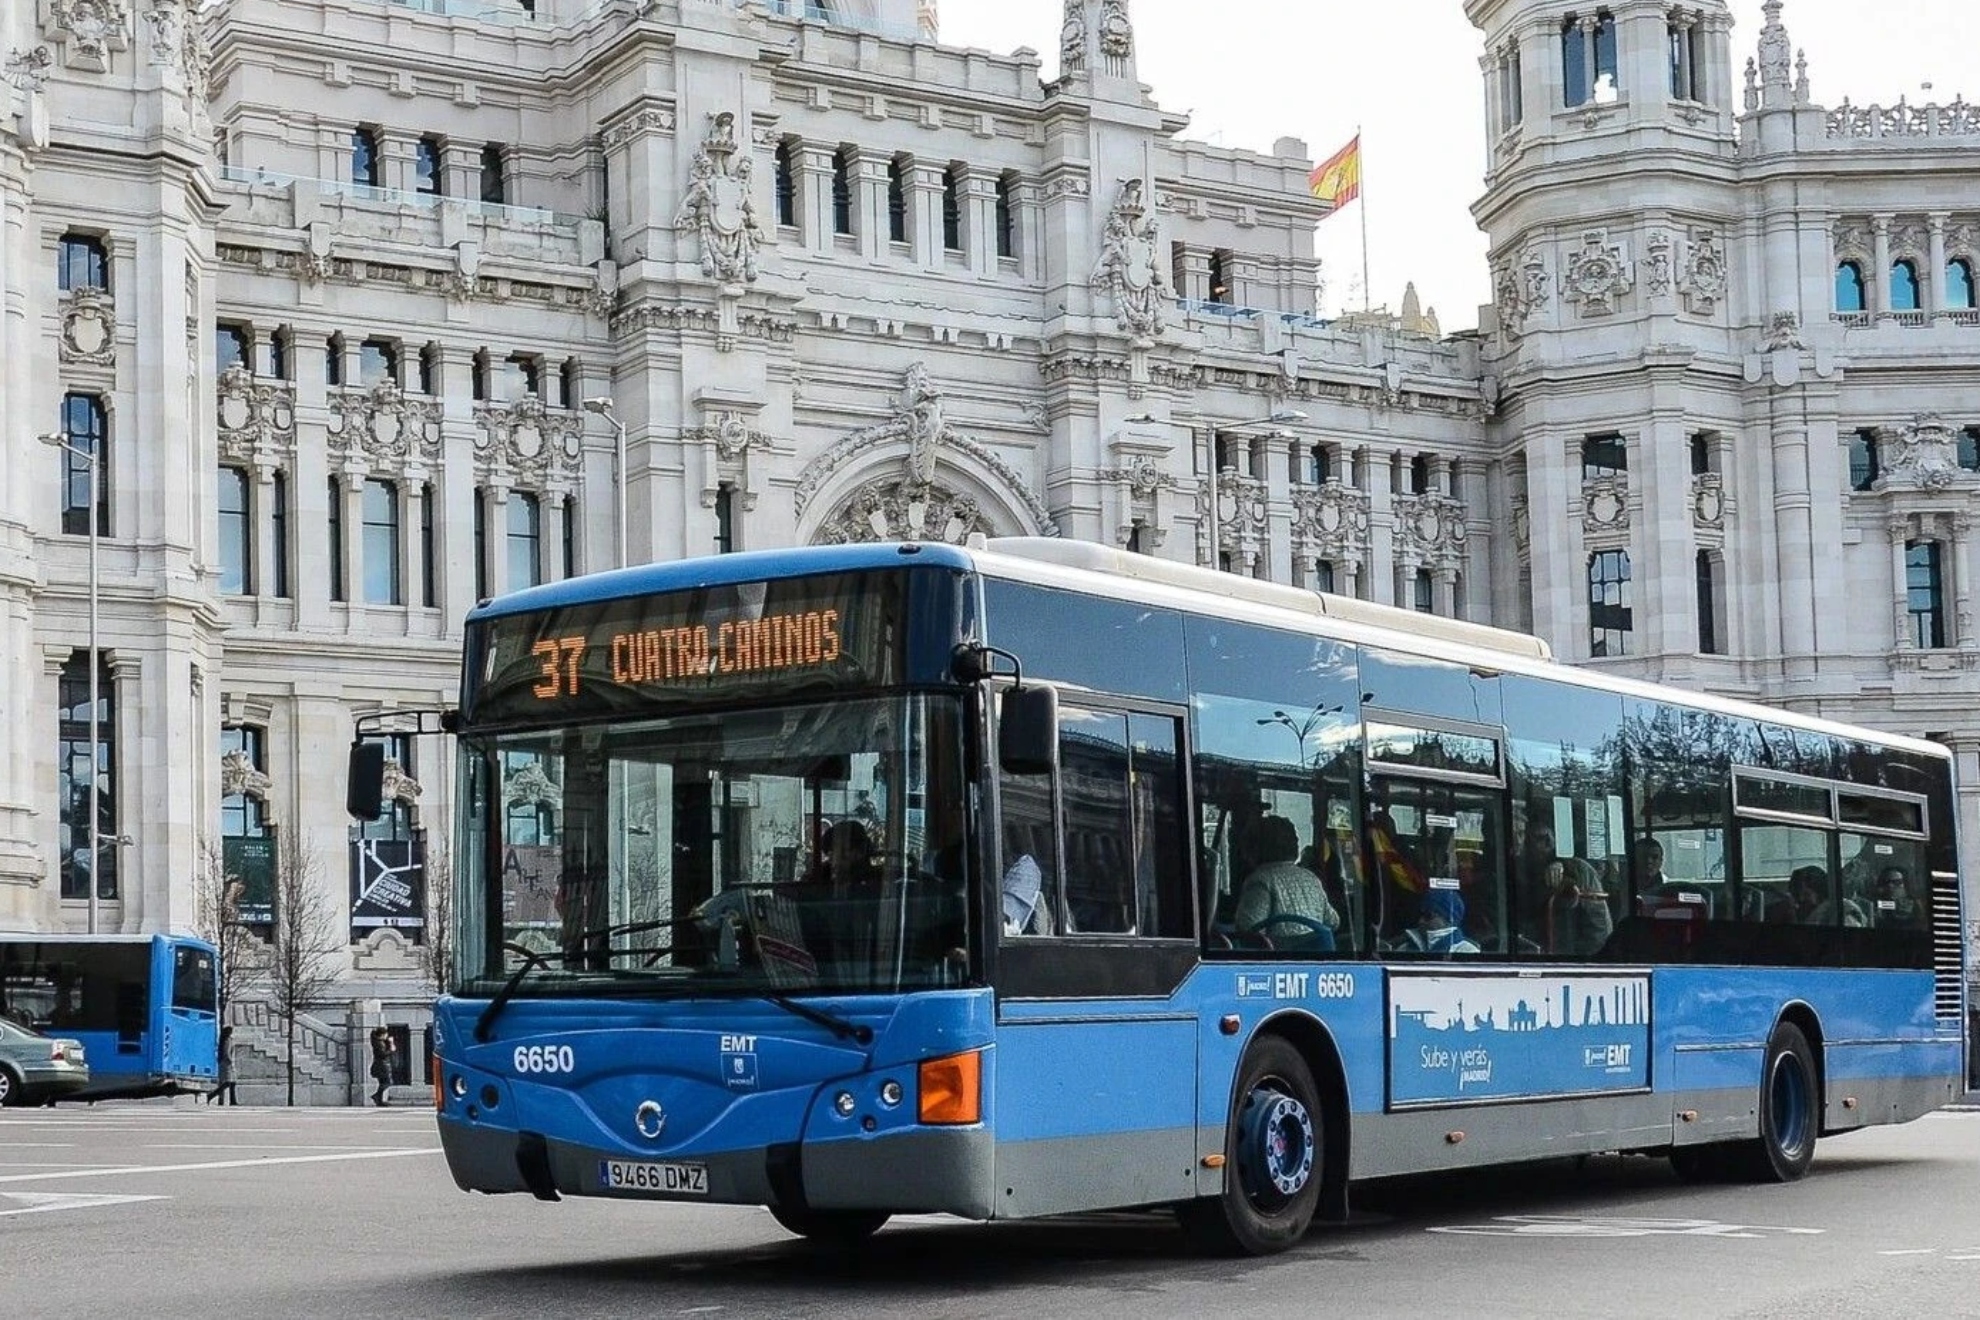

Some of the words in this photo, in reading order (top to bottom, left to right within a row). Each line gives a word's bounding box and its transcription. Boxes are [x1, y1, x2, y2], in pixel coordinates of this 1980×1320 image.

[531, 635, 586, 699] 37
[612, 624, 709, 684] CUATRO
[718, 609, 839, 673] CAMINOS
[1275, 973, 1309, 999] EMT
[1318, 973, 1354, 998] 6650
[721, 1035, 757, 1052] EMT
[1607, 1044, 1631, 1066] EMT
[513, 1044, 575, 1073] 6650
[1421, 1044, 1448, 1068] Sube
[1450, 1051, 1458, 1073] y
[1460, 1043, 1487, 1066] verás
[612, 1164, 660, 1188] 9466
[664, 1167, 705, 1190] DMZ
